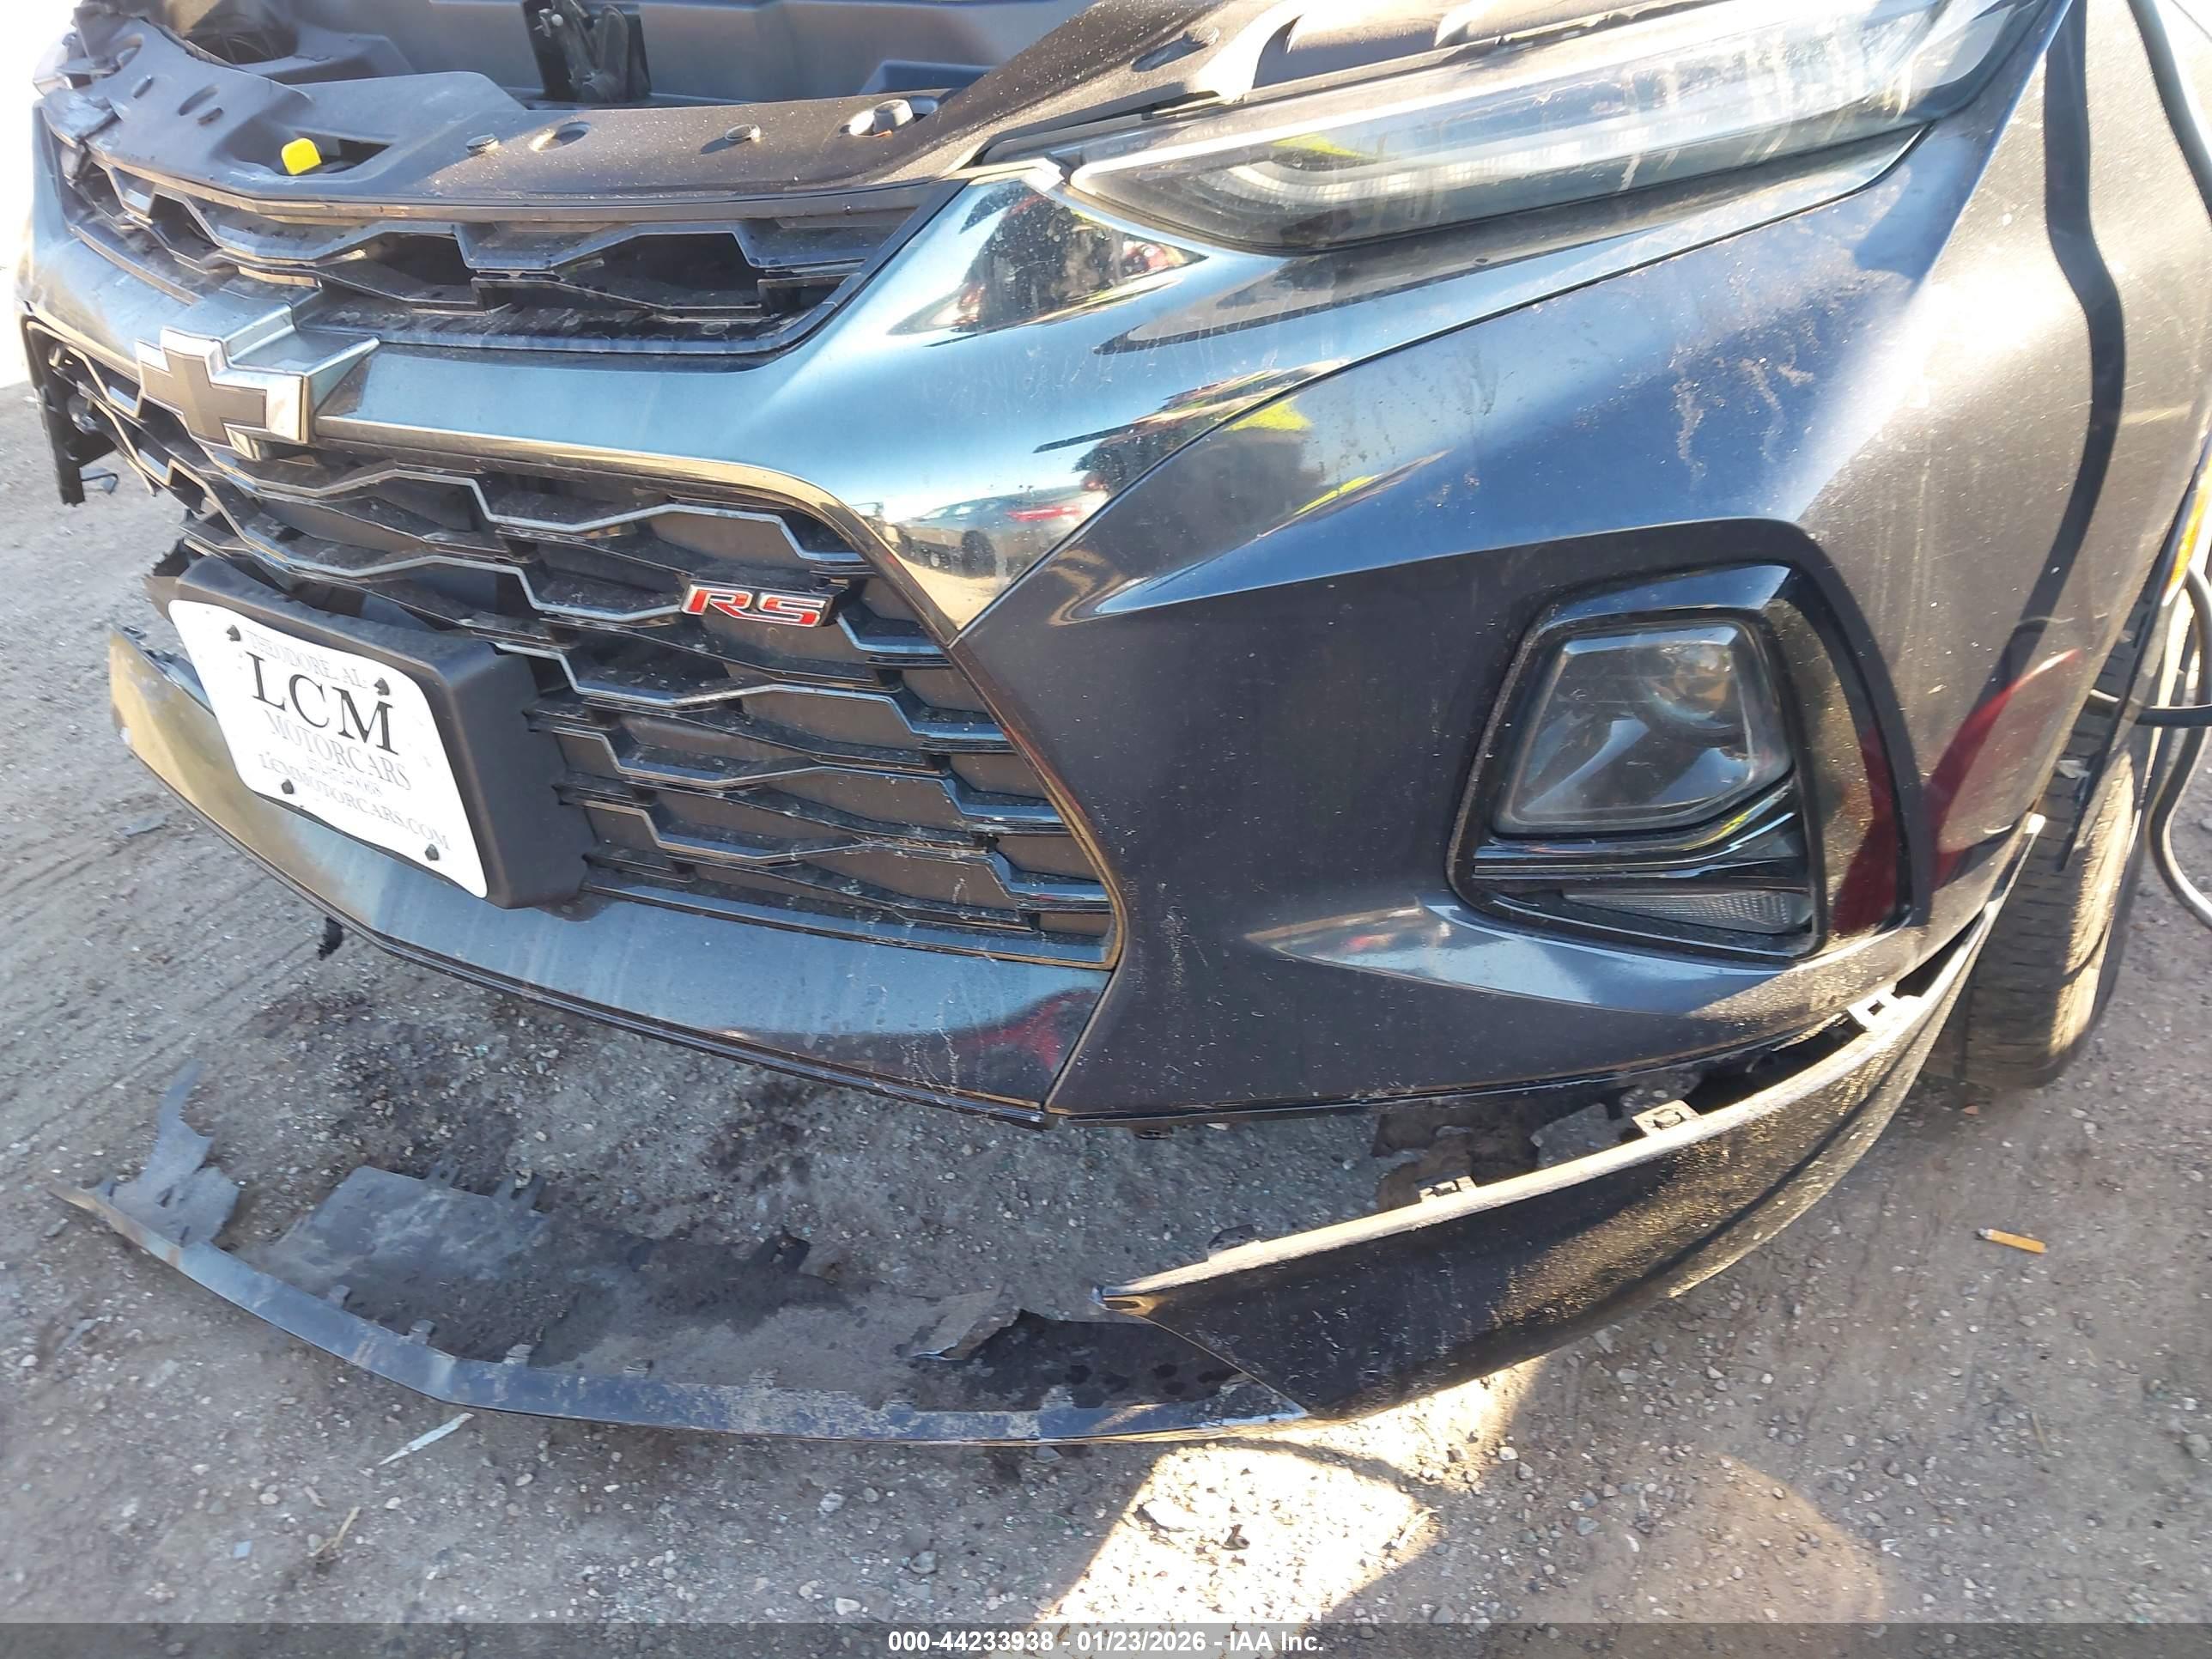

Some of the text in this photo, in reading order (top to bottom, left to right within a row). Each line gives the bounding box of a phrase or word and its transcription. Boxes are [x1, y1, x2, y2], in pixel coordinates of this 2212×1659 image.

[681, 583, 826, 628] RS
[246, 651, 398, 756] LCM
[263, 710, 412, 791] MOTORCARS
